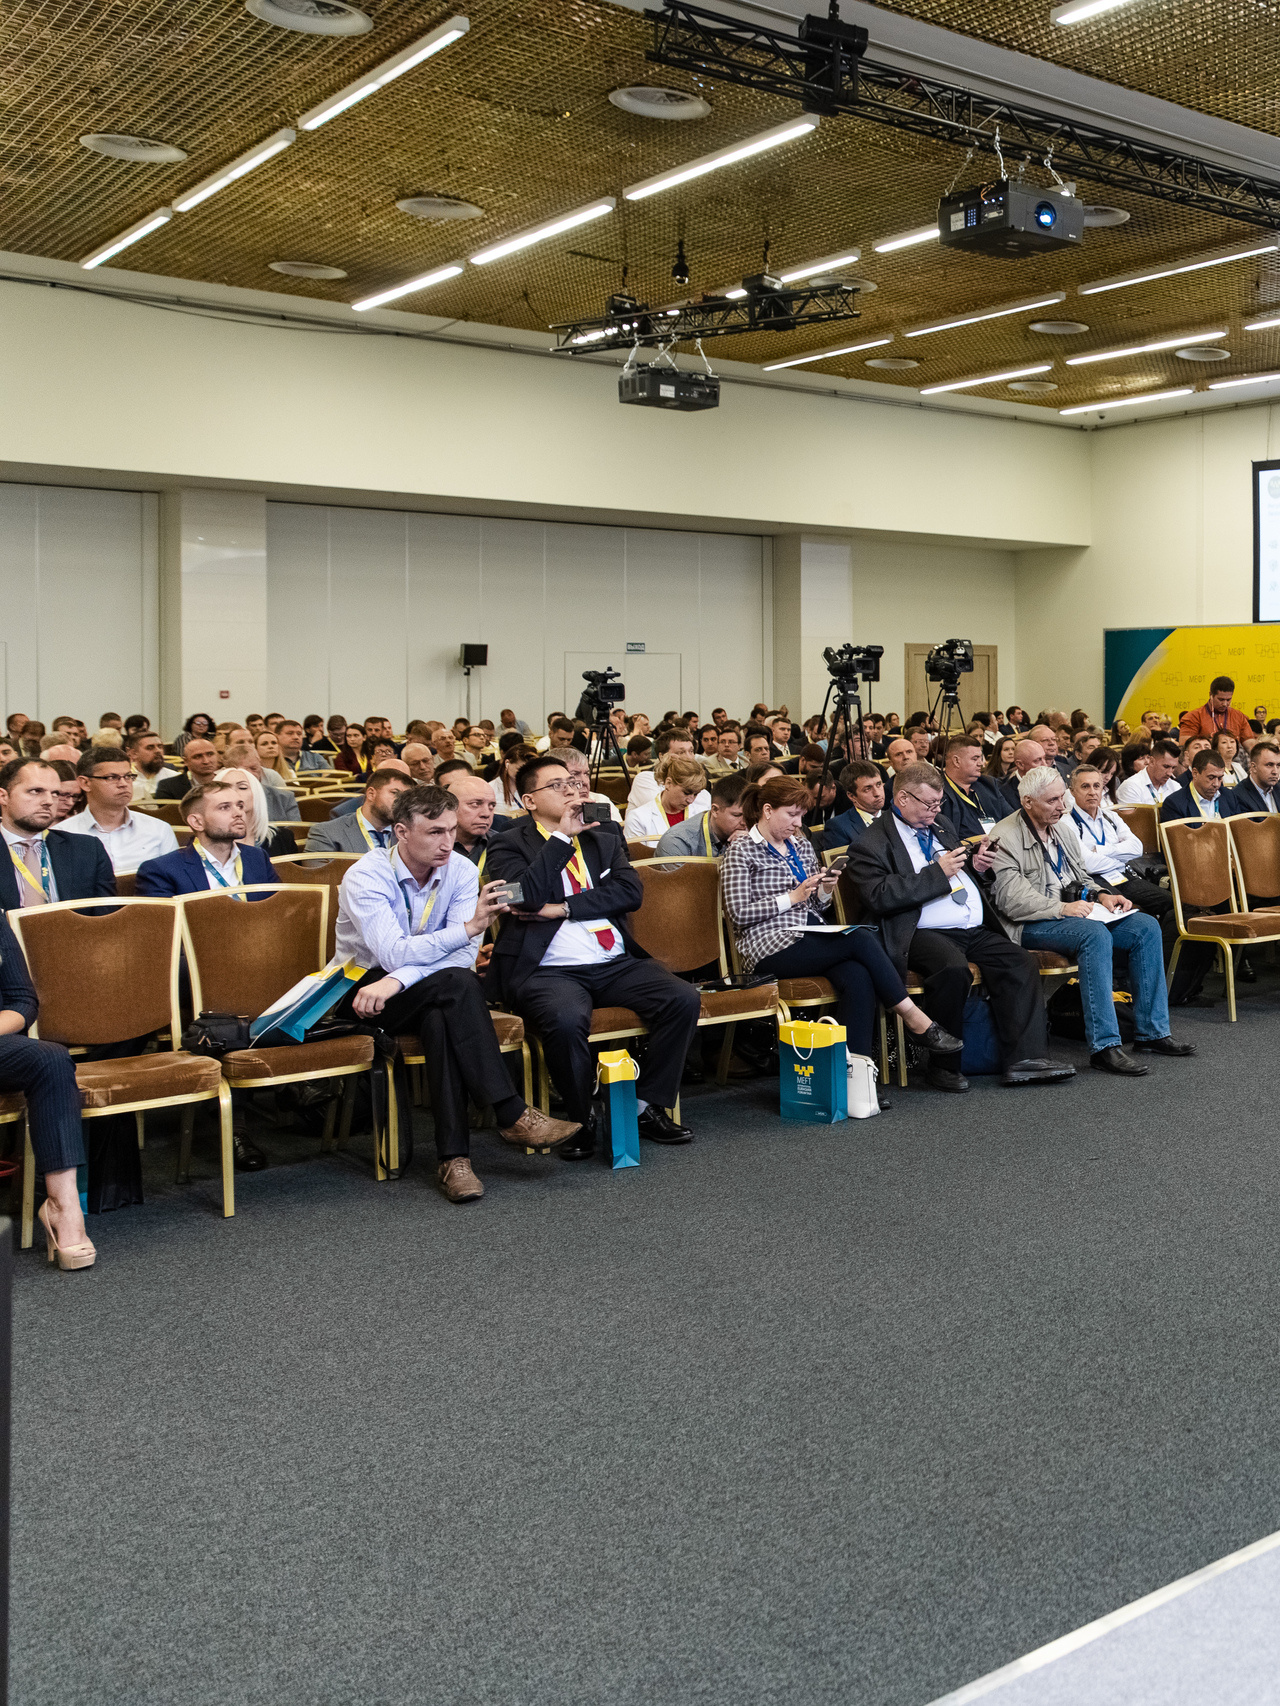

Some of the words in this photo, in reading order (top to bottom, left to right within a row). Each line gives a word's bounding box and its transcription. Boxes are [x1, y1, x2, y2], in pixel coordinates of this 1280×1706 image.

[1228, 647, 1246, 656] МЕФТ
[1189, 675, 1206, 683] МЕФТ
[1248, 674, 1266, 683] МЕФТ
[1174, 701, 1191, 710] МЕФТ
[797, 1076, 812, 1085] MEFT
